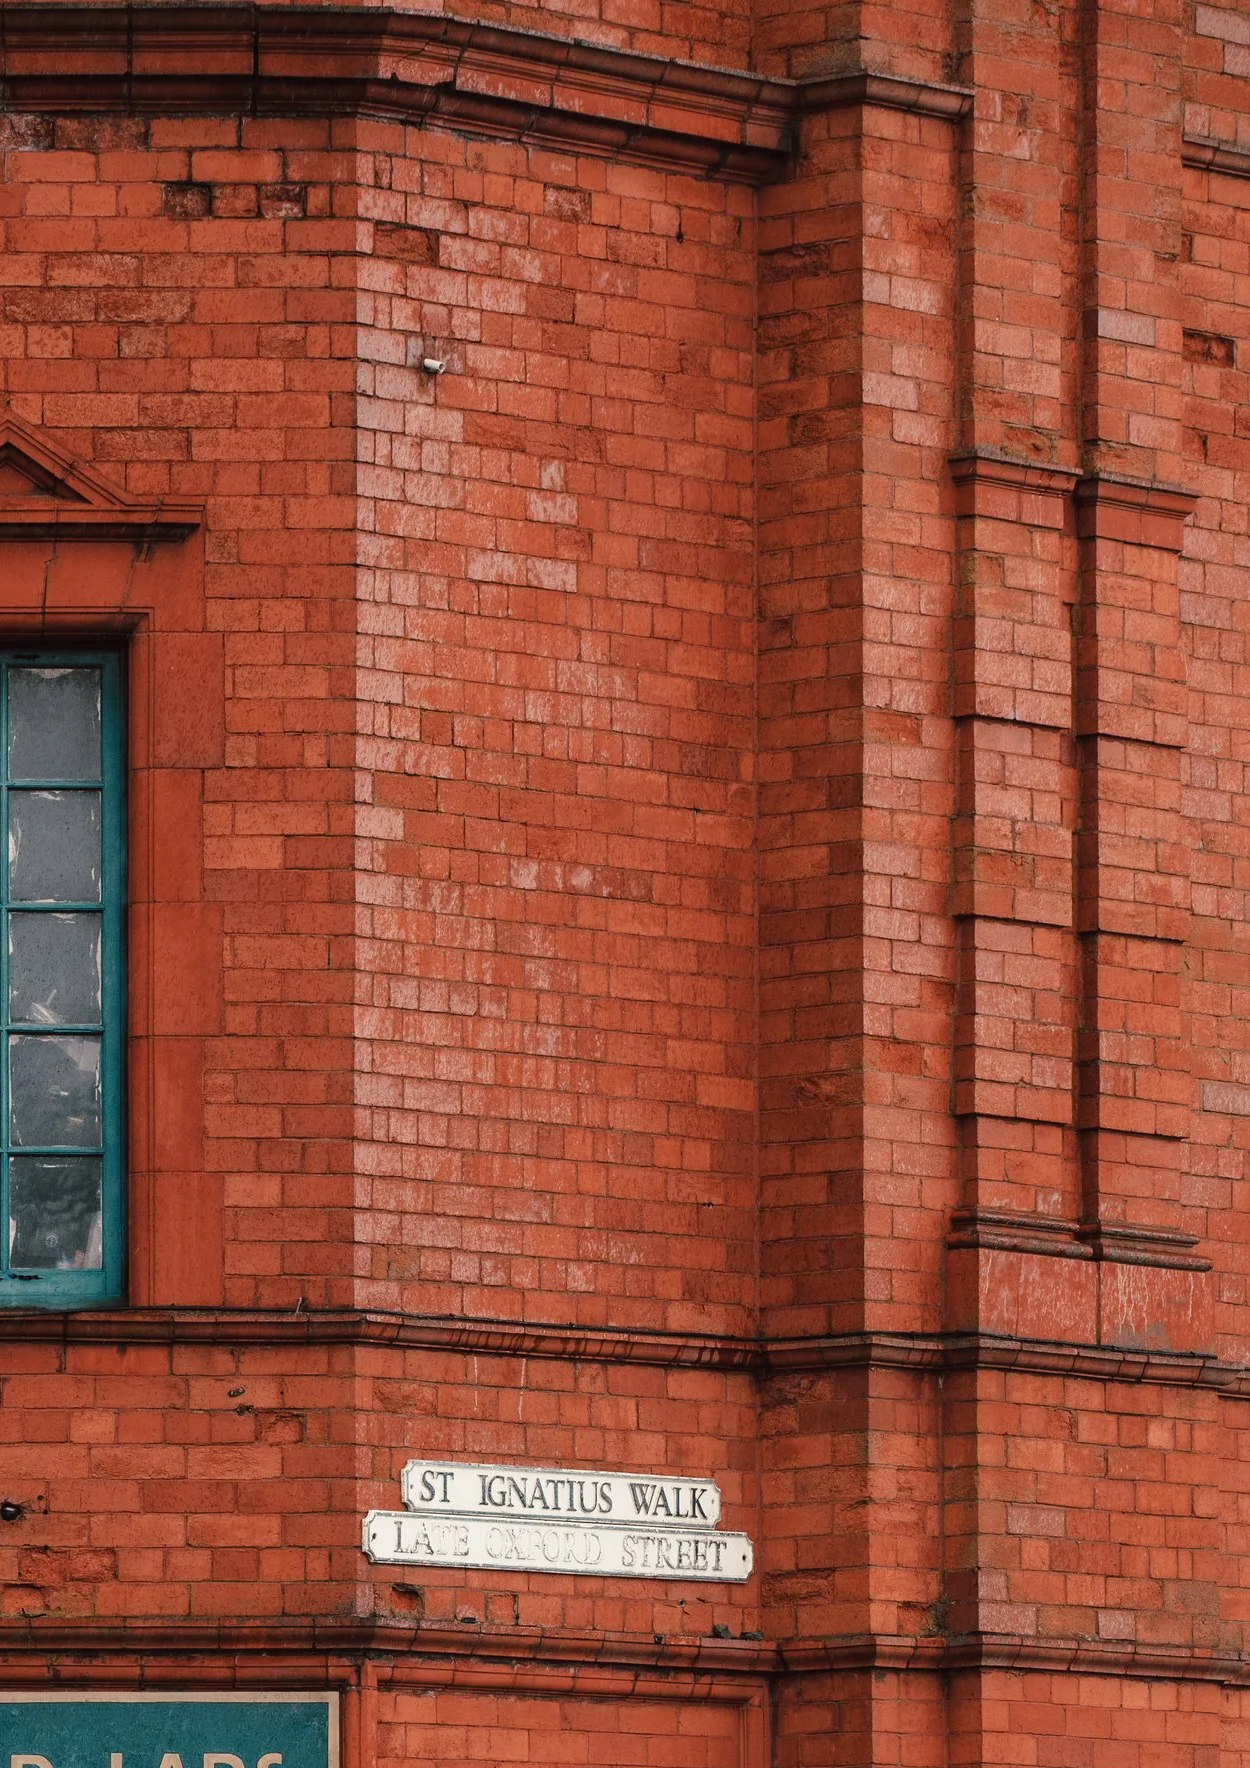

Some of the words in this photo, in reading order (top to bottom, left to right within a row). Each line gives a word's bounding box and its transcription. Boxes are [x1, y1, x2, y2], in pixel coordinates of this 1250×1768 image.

[419, 1470, 454, 1503] ST
[478, 1474, 613, 1514] IGNATIUS
[629, 1482, 708, 1519] WALK
[393, 1521, 469, 1557] LATE
[485, 1527, 603, 1565] OXFORD
[621, 1535, 727, 1572] STREET
